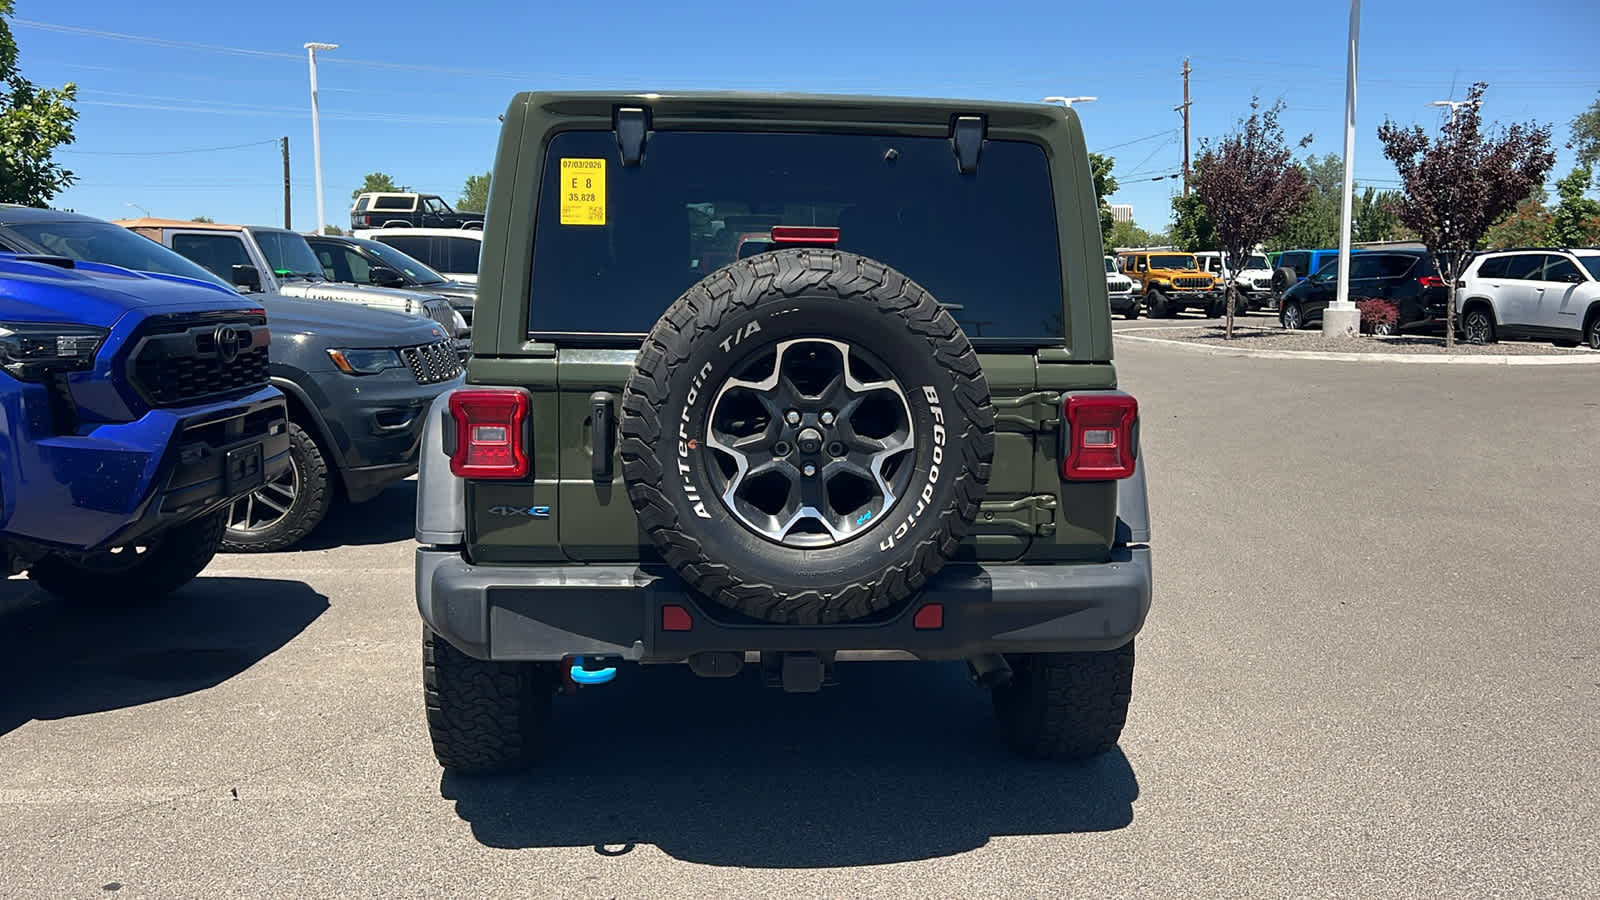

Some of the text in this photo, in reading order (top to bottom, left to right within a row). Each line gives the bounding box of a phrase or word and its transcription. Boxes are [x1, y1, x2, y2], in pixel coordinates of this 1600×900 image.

[562, 160, 602, 169] 07/03/2026
[571, 177, 592, 189] E 8
[677, 320, 761, 519] All-Terrain T/A
[879, 385, 947, 552] BFGoodrich
